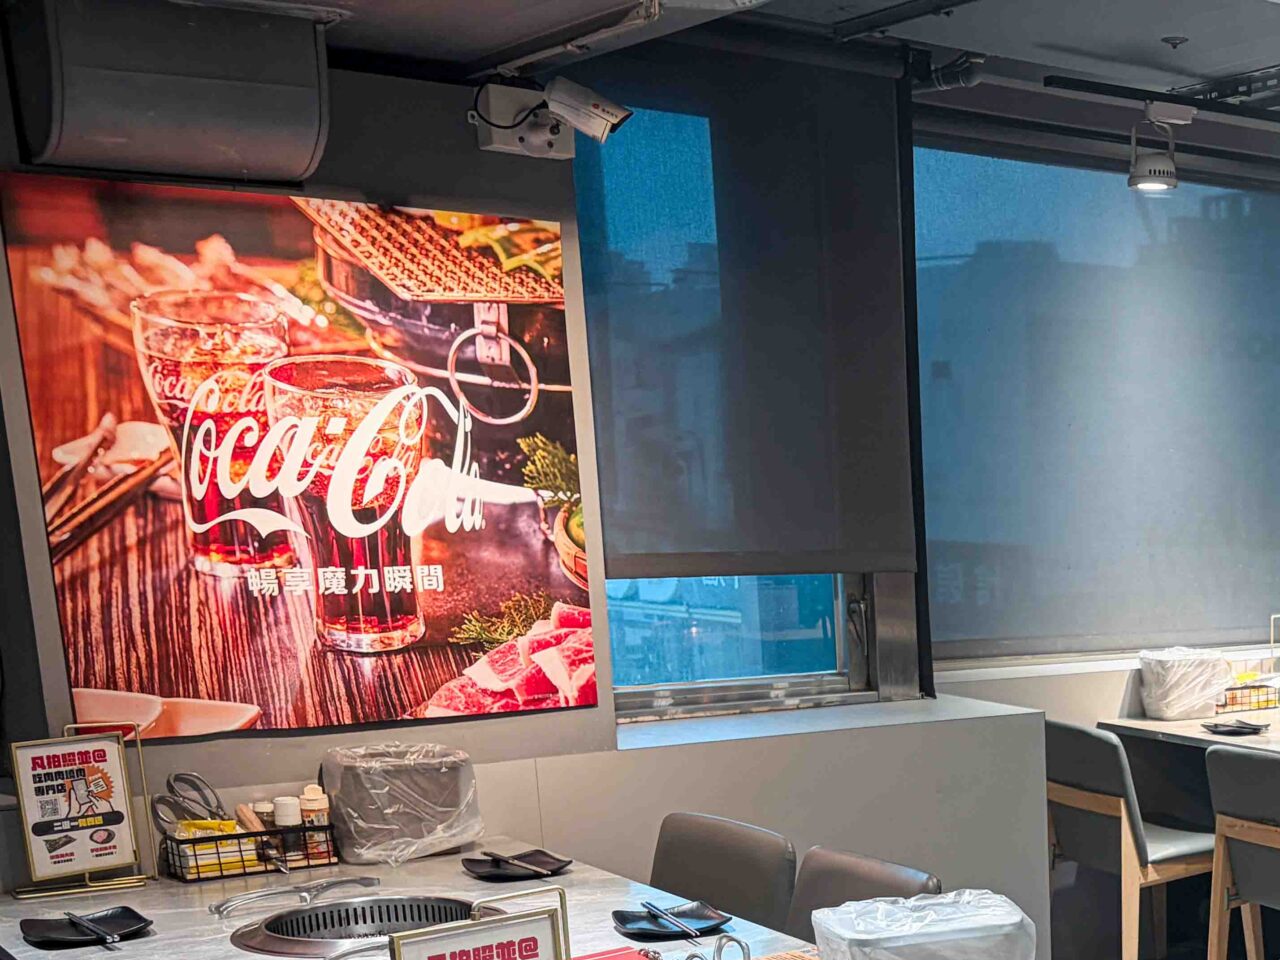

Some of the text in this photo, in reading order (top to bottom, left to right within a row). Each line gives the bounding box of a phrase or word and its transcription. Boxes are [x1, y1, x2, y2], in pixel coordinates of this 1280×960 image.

[246, 564, 446, 598] 暢享魔力瞬間
